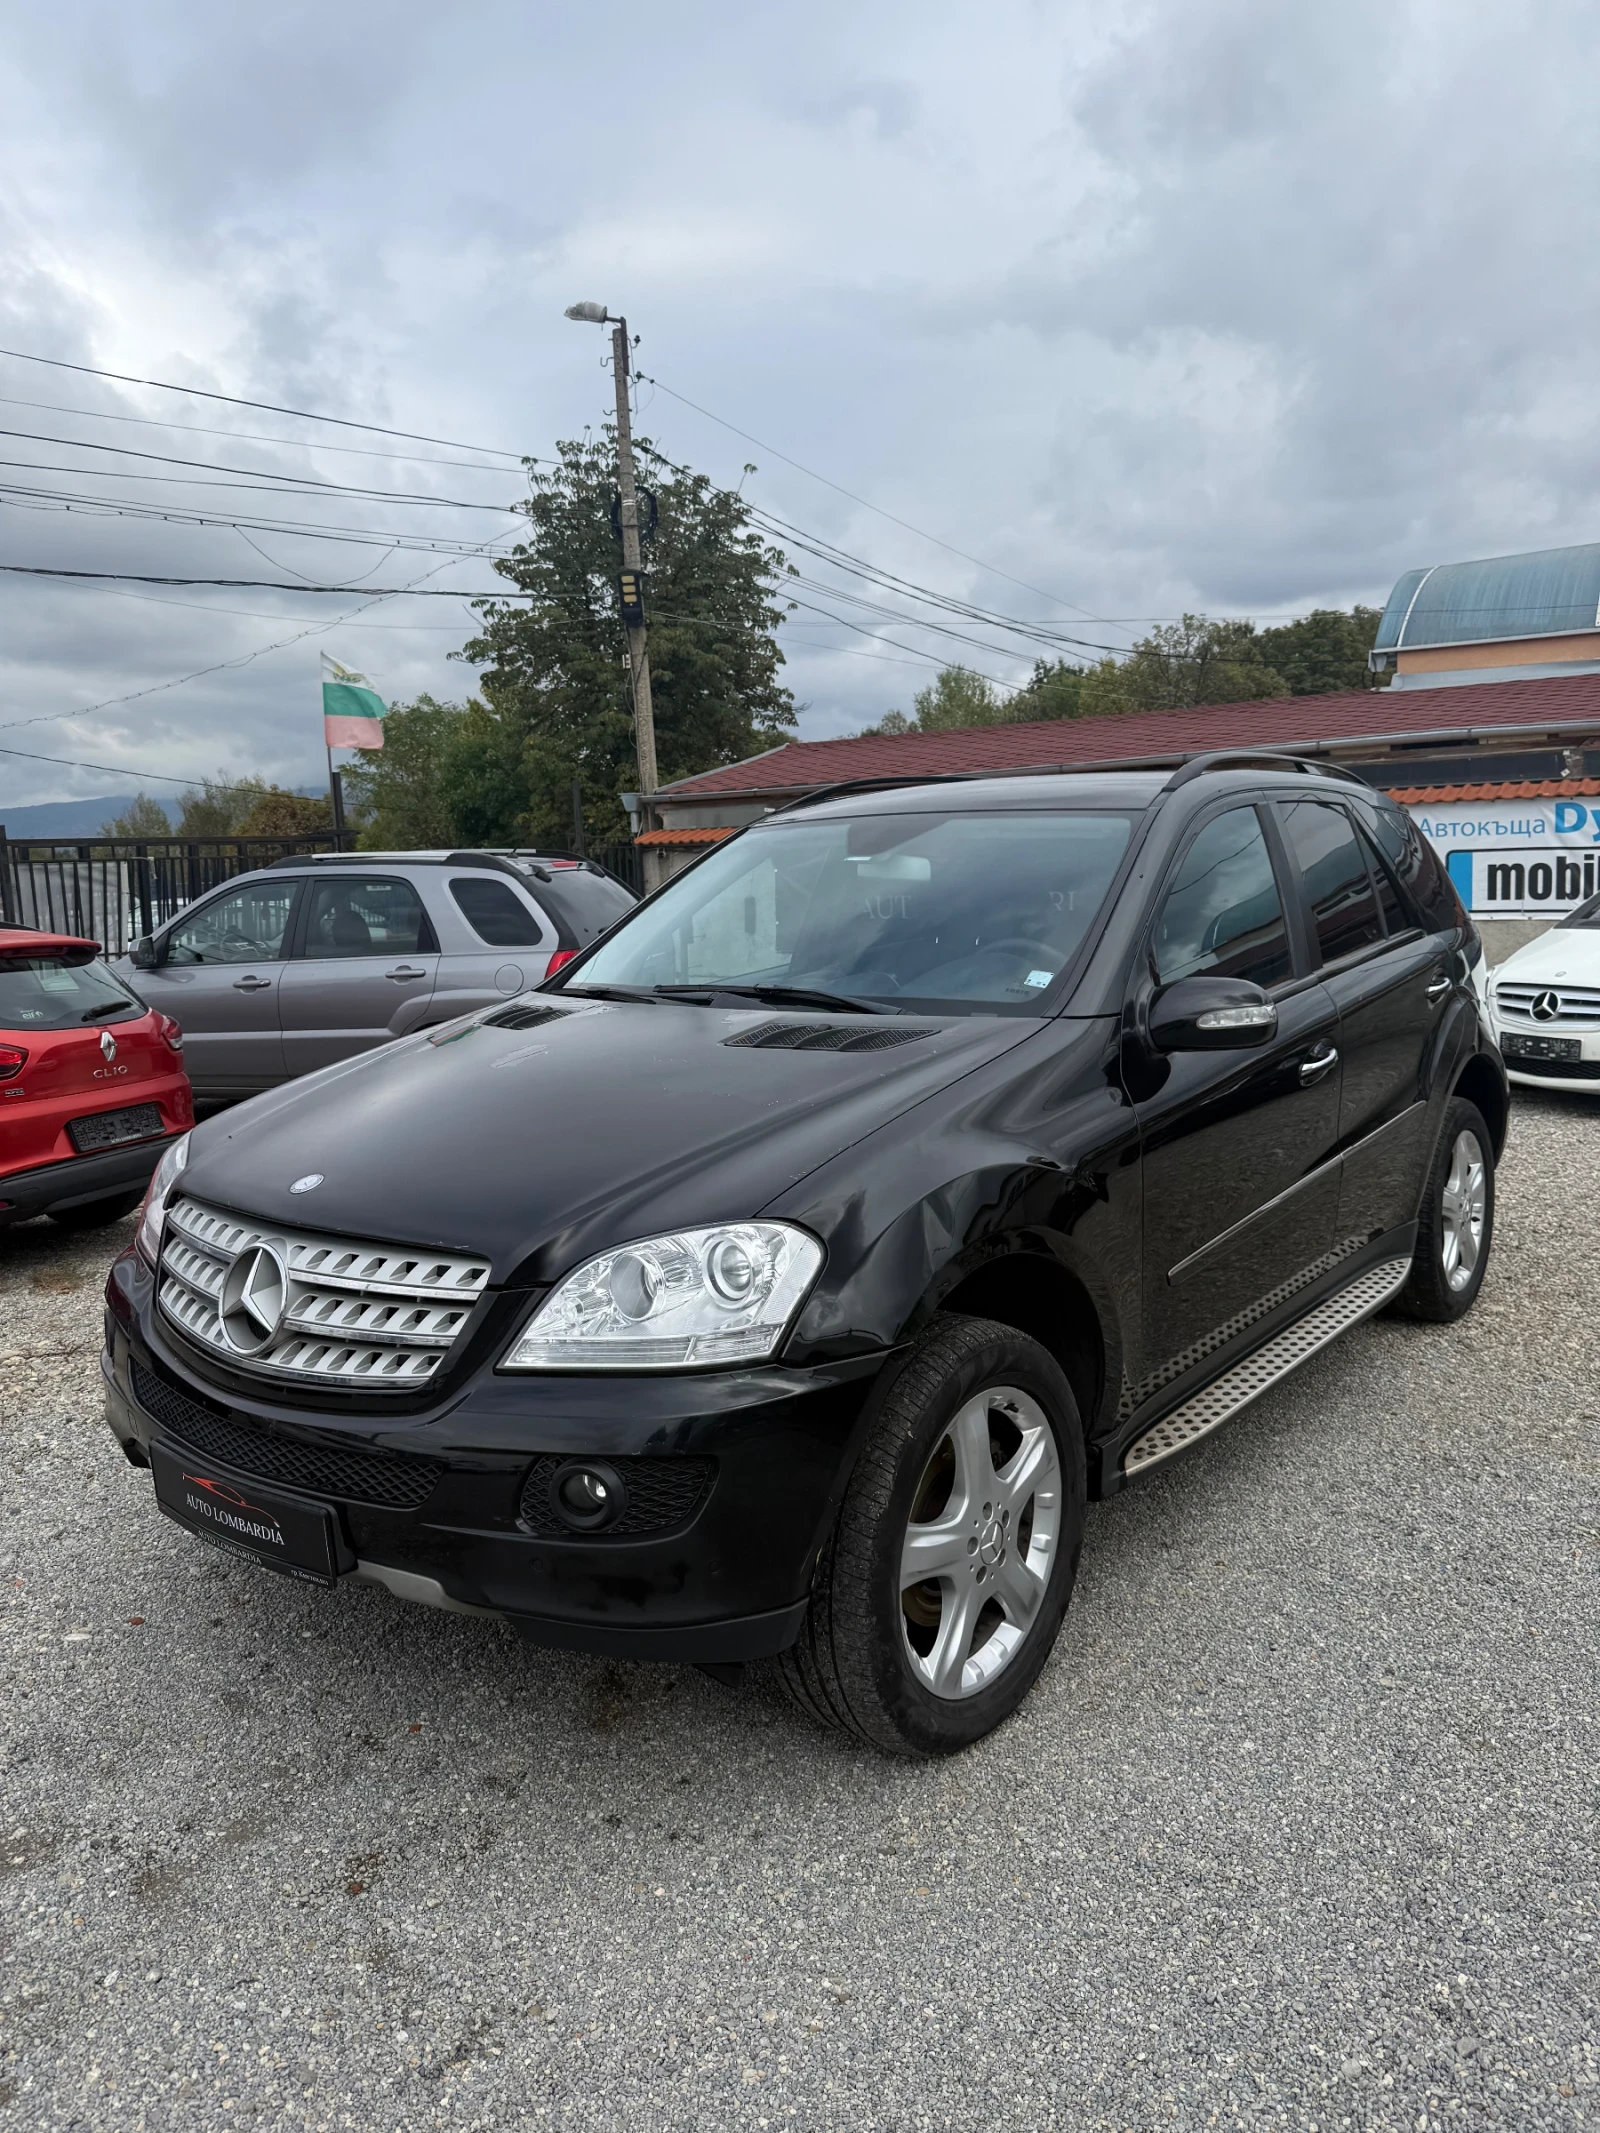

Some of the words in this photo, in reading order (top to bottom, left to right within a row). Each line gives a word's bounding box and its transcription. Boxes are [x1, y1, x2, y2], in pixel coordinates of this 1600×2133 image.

[1420, 818, 1545, 840] Автокъща
[1487, 854, 1600, 900] mobi
[93, 1065, 128, 1079] CLIO
[186, 1493, 212, 1516] AUTO
[213, 1506, 285, 1545] LOMBARDIA
[198, 1530, 216, 1545] AUTO
[216, 1540, 262, 1565] LOMBARDIA
